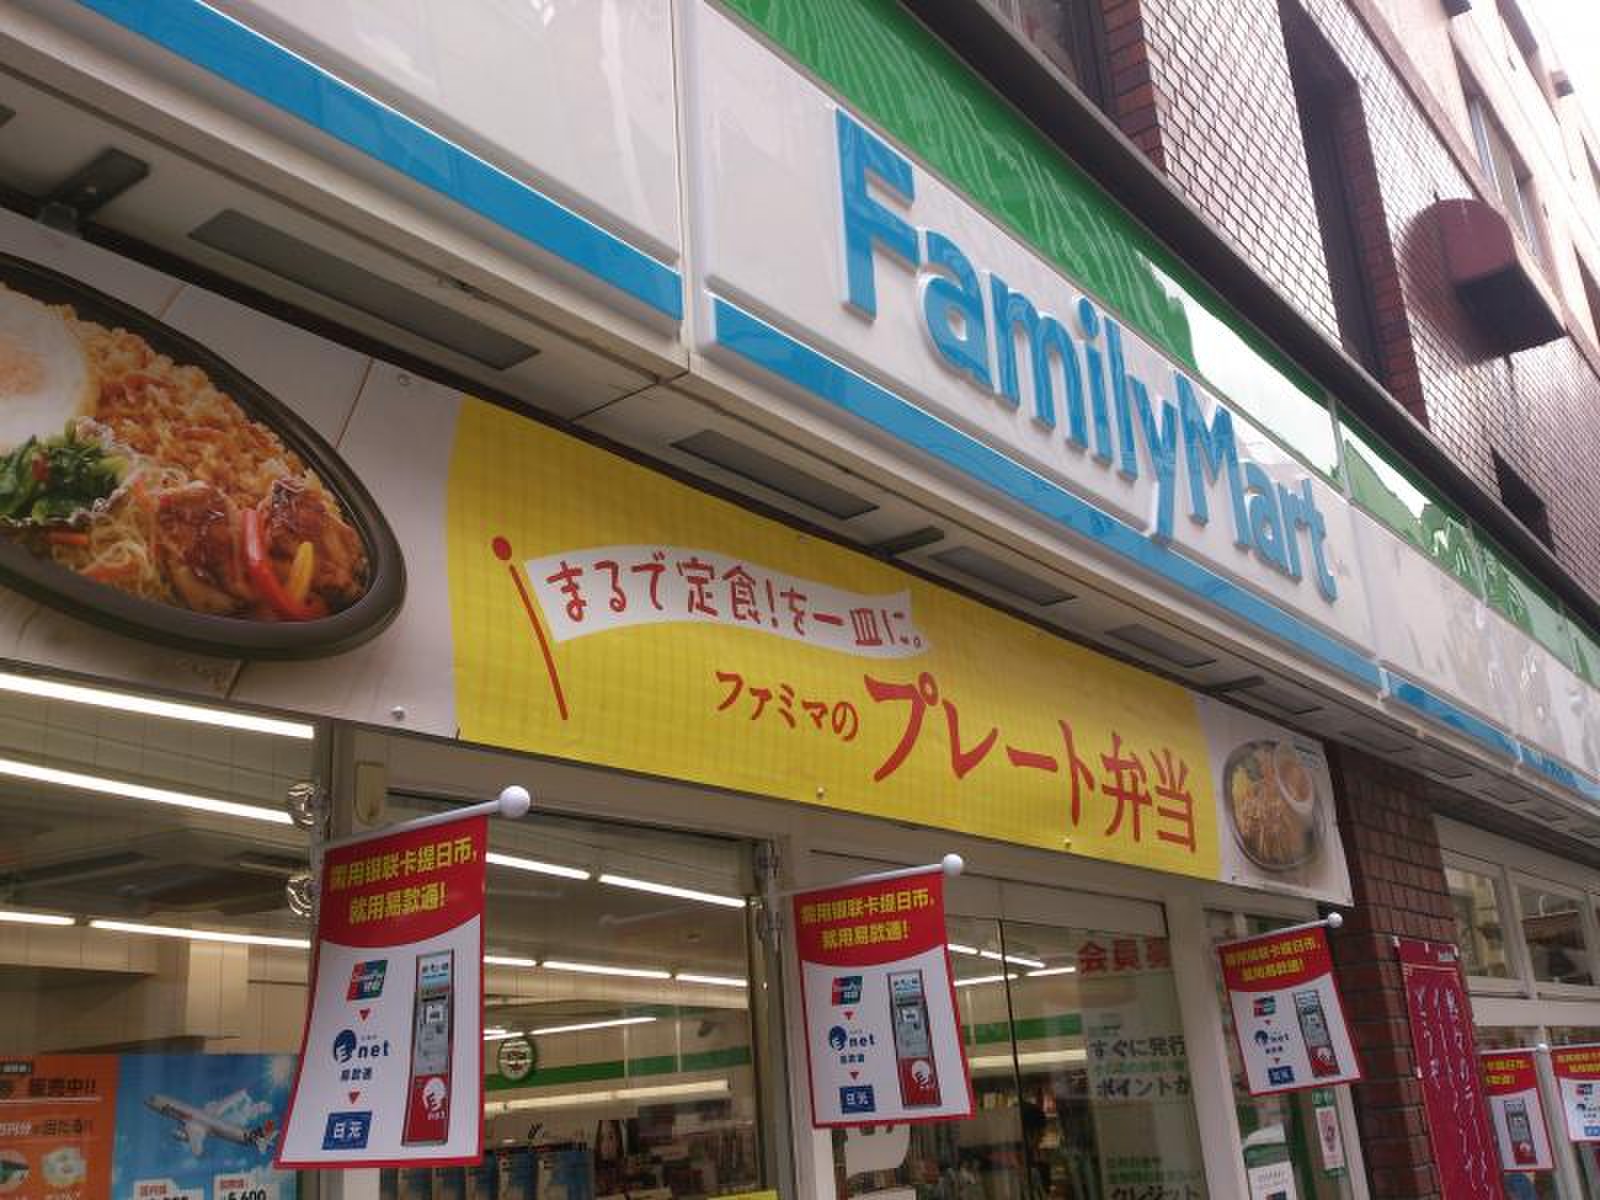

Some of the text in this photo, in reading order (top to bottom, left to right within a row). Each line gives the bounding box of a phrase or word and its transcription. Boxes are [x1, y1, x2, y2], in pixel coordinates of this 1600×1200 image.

[836, 107, 1338, 602] FamilyMart
[715, 670, 1197, 854] ファミマの プレート弁当
